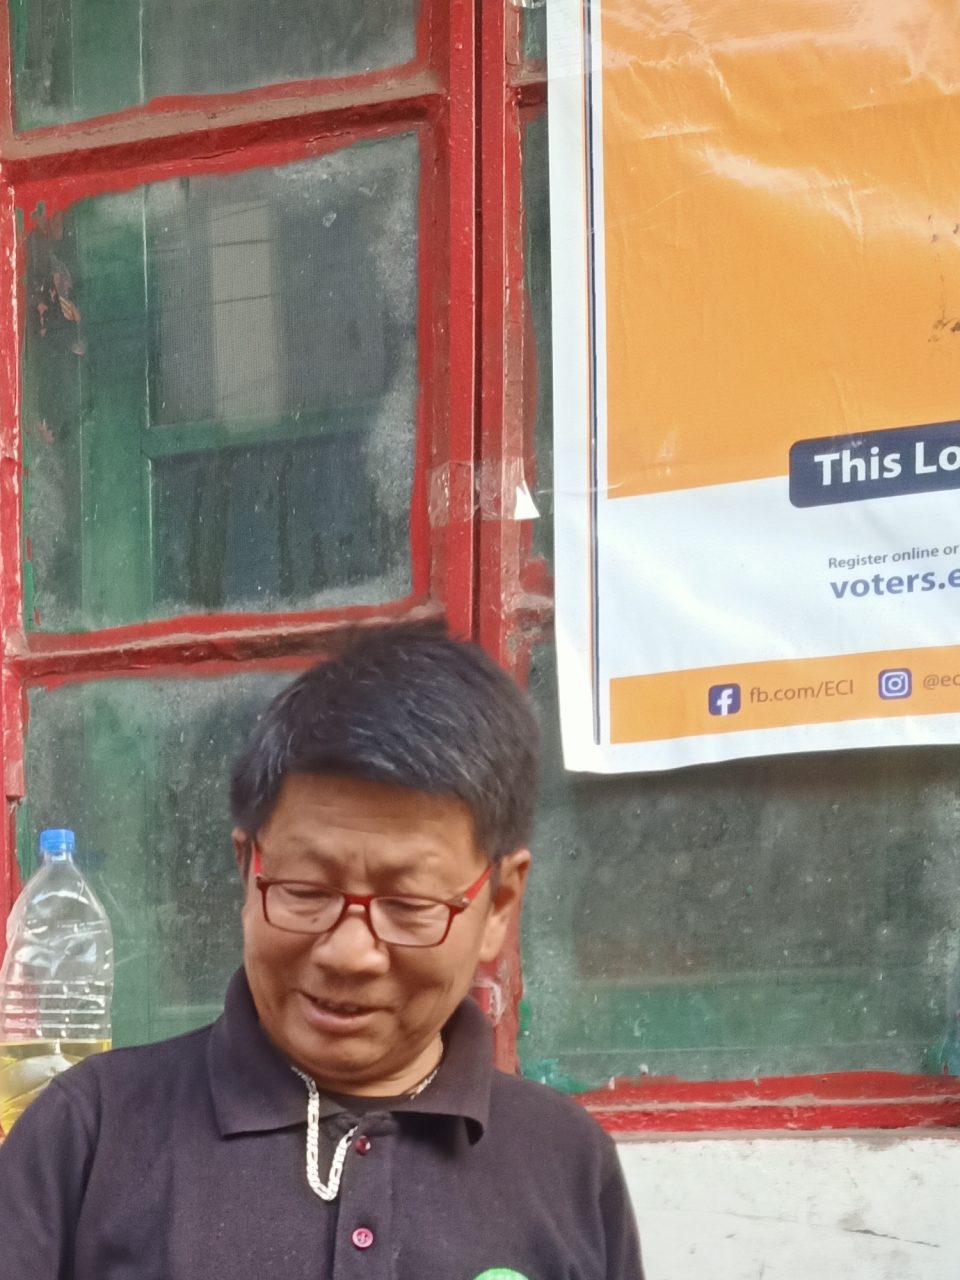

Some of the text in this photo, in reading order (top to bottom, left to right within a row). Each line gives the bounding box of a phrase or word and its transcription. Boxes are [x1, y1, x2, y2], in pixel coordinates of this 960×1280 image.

[814, 441, 960, 486] This Lo
[828, 544, 959, 570] Register online or
[830, 568, 960, 599] voters.e
[749, 679, 854, 703] fb.com/ECI
